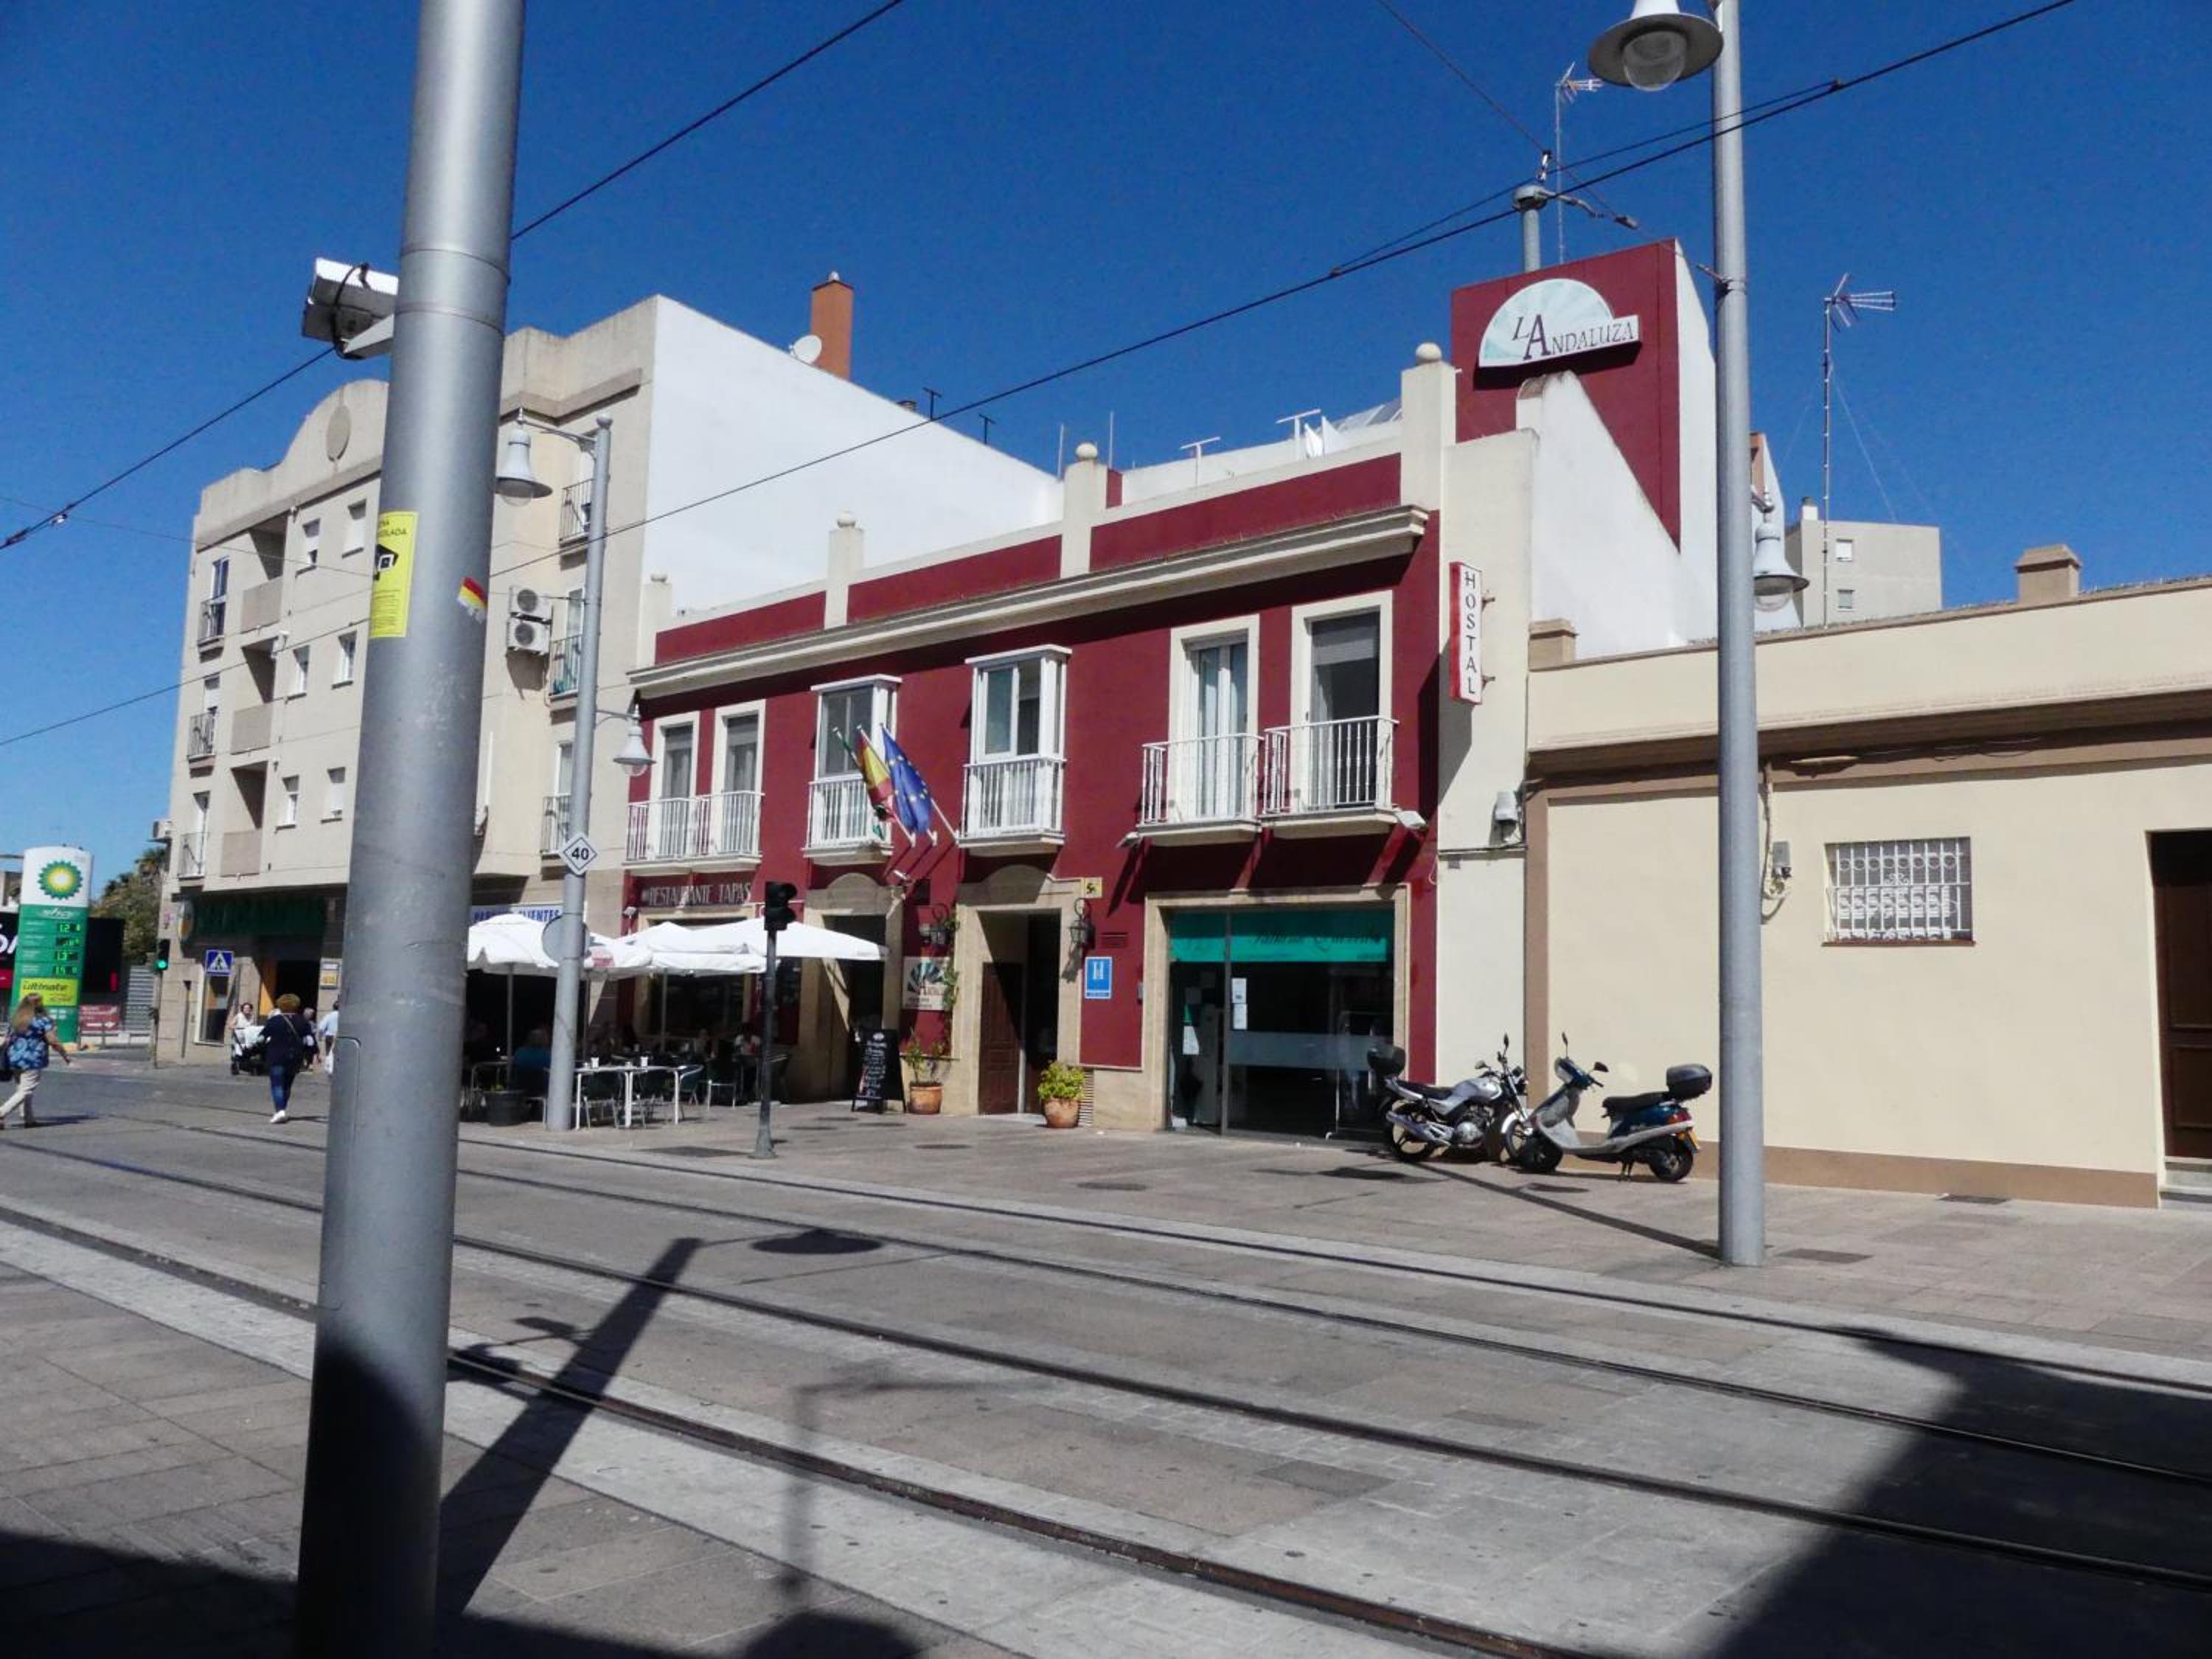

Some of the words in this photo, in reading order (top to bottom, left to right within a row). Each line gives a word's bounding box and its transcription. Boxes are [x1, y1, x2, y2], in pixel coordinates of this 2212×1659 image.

[1465, 571, 1477, 694] HOSTAL
[571, 847, 589, 860] 40
[649, 885, 712, 906] RESTAURANTE
[720, 882, 751, 904] TAPAS
